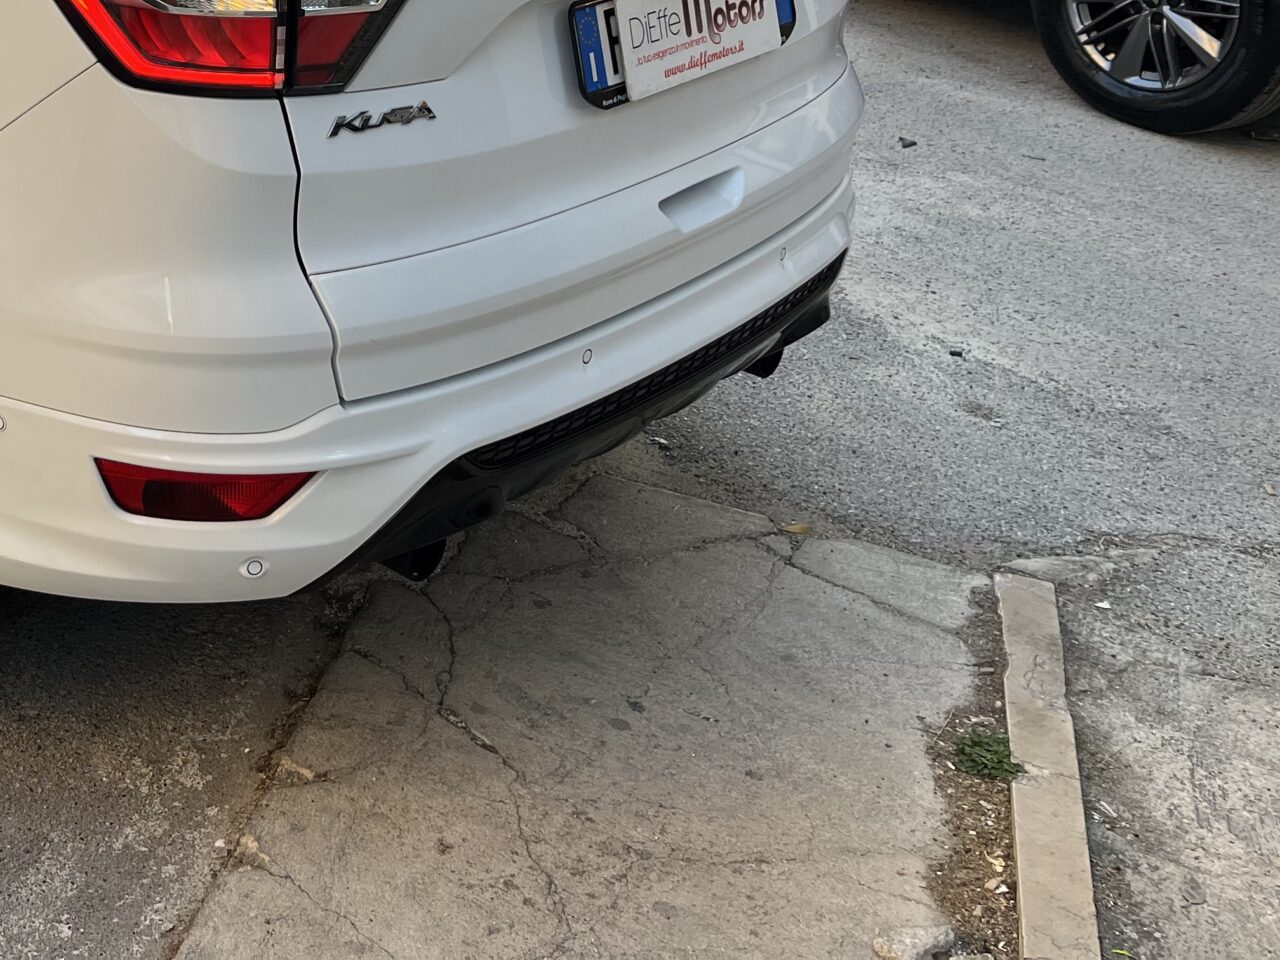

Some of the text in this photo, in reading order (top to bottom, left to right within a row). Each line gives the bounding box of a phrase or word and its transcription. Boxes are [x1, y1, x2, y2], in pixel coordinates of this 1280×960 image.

[628, 7, 681, 50] DiEffe
[664, 40, 745, 79] www.dieffemotors.it
[327, 101, 437, 138] KUGA
